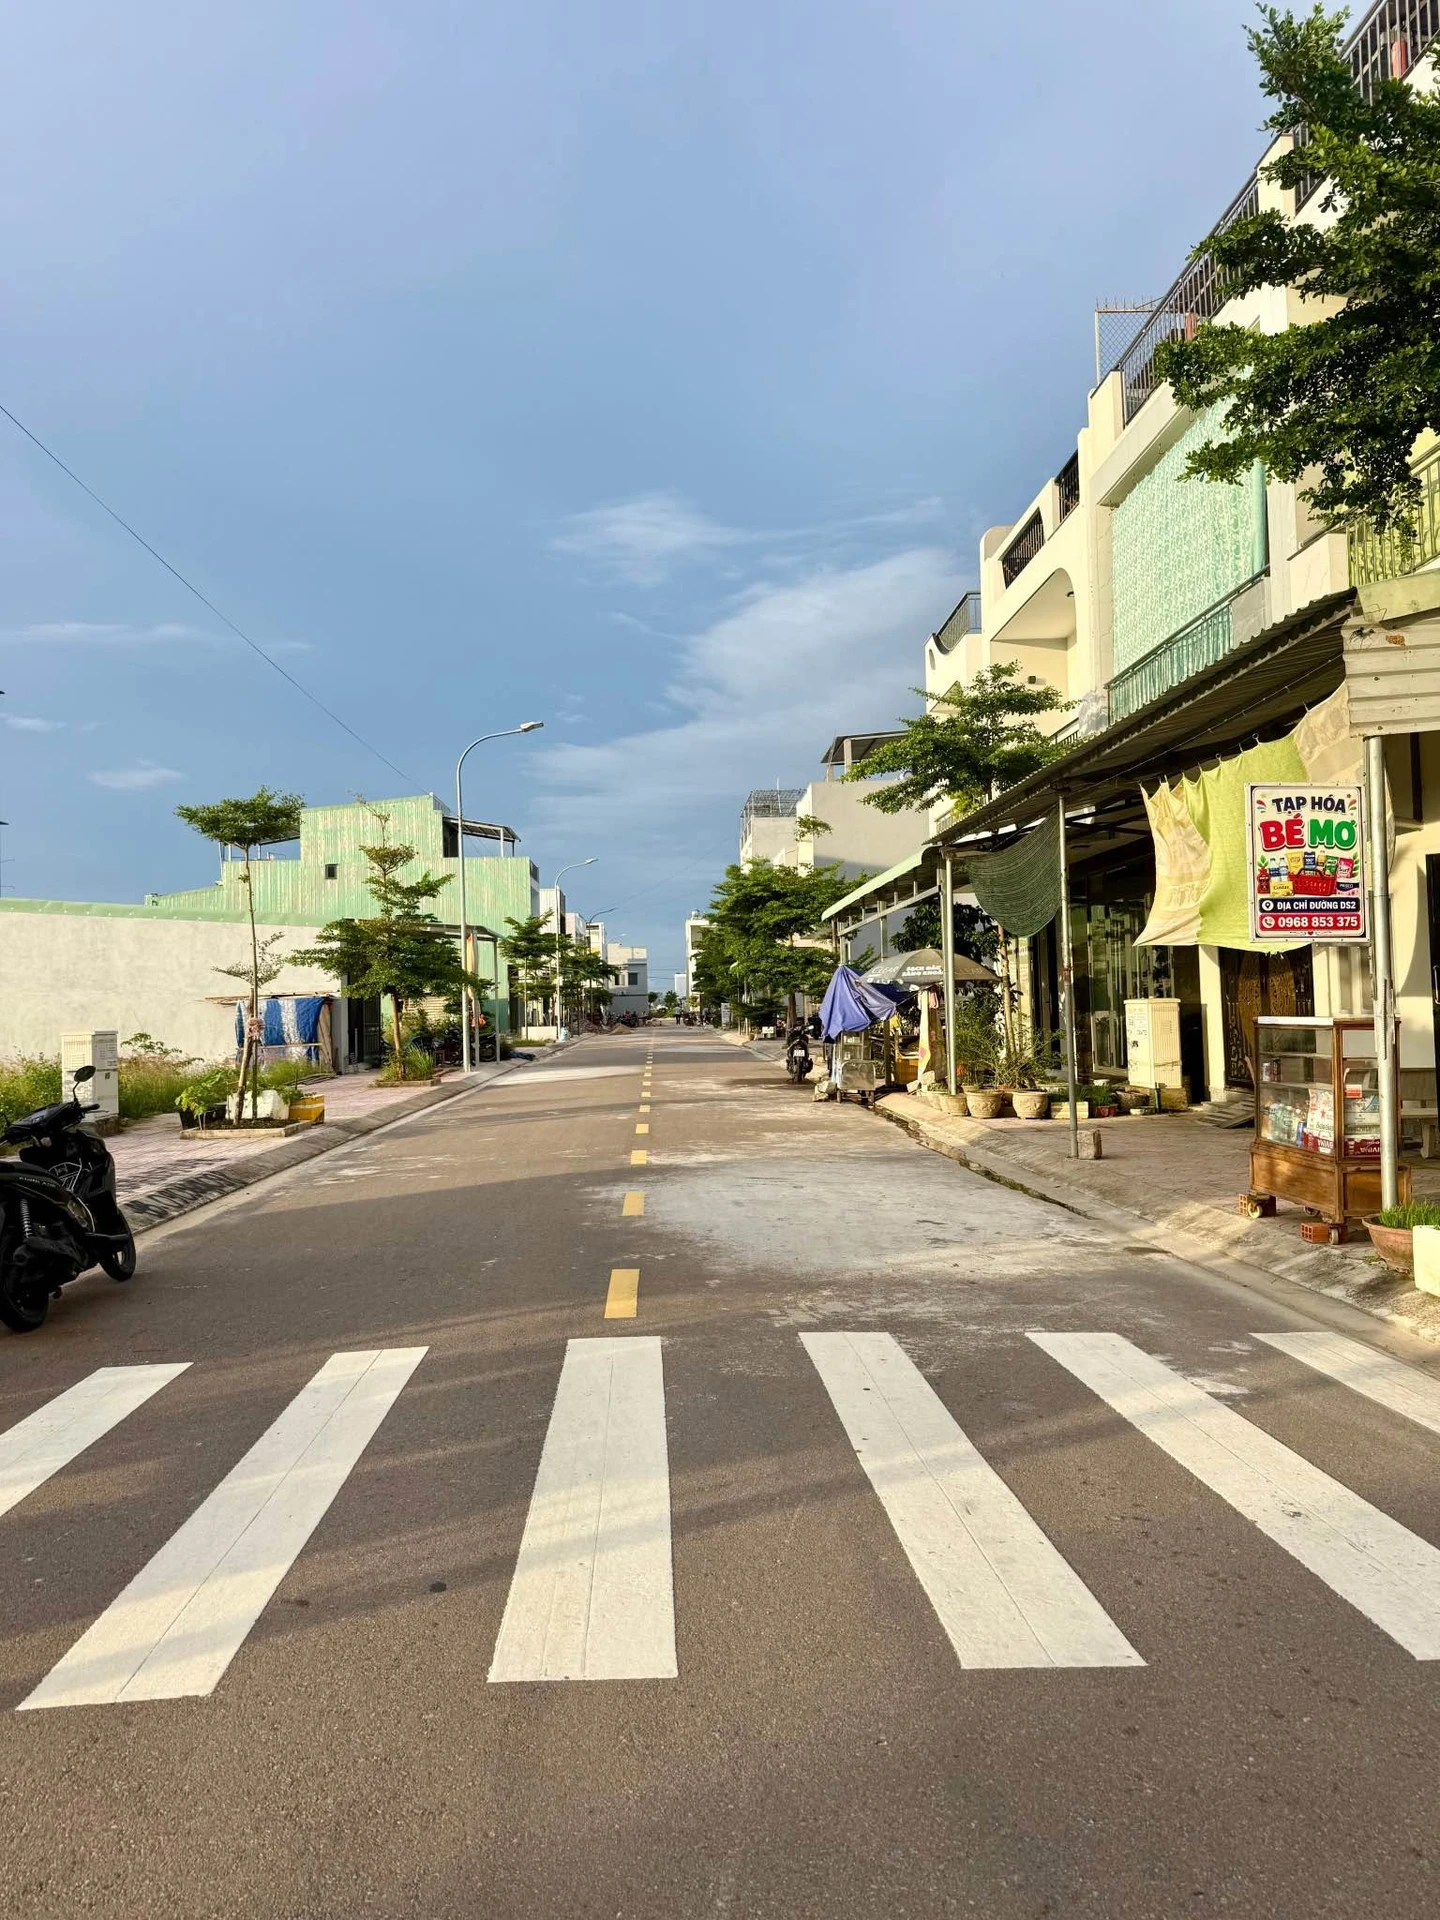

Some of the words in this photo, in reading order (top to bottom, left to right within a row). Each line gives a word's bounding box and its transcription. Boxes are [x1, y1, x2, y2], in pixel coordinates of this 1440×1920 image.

[1272, 796, 1307, 814] TẠP
[1311, 794, 1346, 813] HÓA
[1259, 813, 1305, 850] BÉ
[1309, 819, 1356, 850] MƠ
[1277, 902, 1291, 911] ĐỊA
[1340, 901, 1356, 909] DS2
[1278, 917, 1308, 927] 0968
[1311, 917, 1334, 927] 853
[1337, 916, 1358, 927] 375
